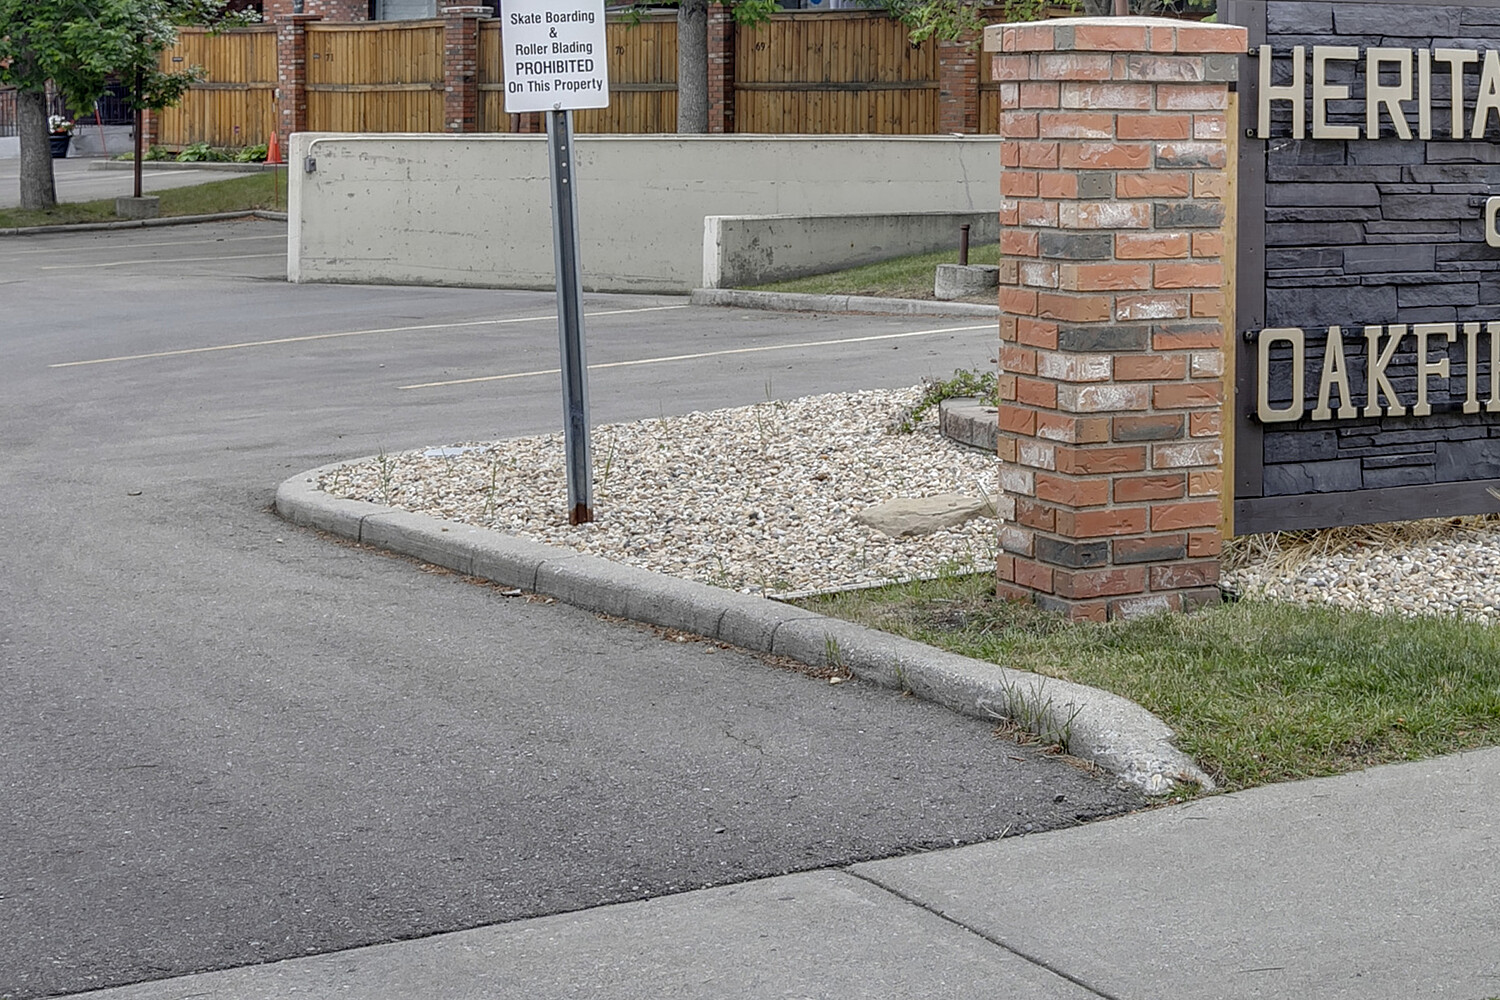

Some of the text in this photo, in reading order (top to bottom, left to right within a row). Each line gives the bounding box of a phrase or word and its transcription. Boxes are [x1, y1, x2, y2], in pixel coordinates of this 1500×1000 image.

[510, 10, 595, 25] Skate Boarding
[549, 27, 558, 38] &
[515, 41, 593, 56] Roller Blading
[615, 46, 625, 55] 70
[755, 42, 766, 51] 69
[326, 53, 334, 62] 71
[516, 59, 594, 75] PROHIBITED
[508, 78, 603, 93] On This Property
